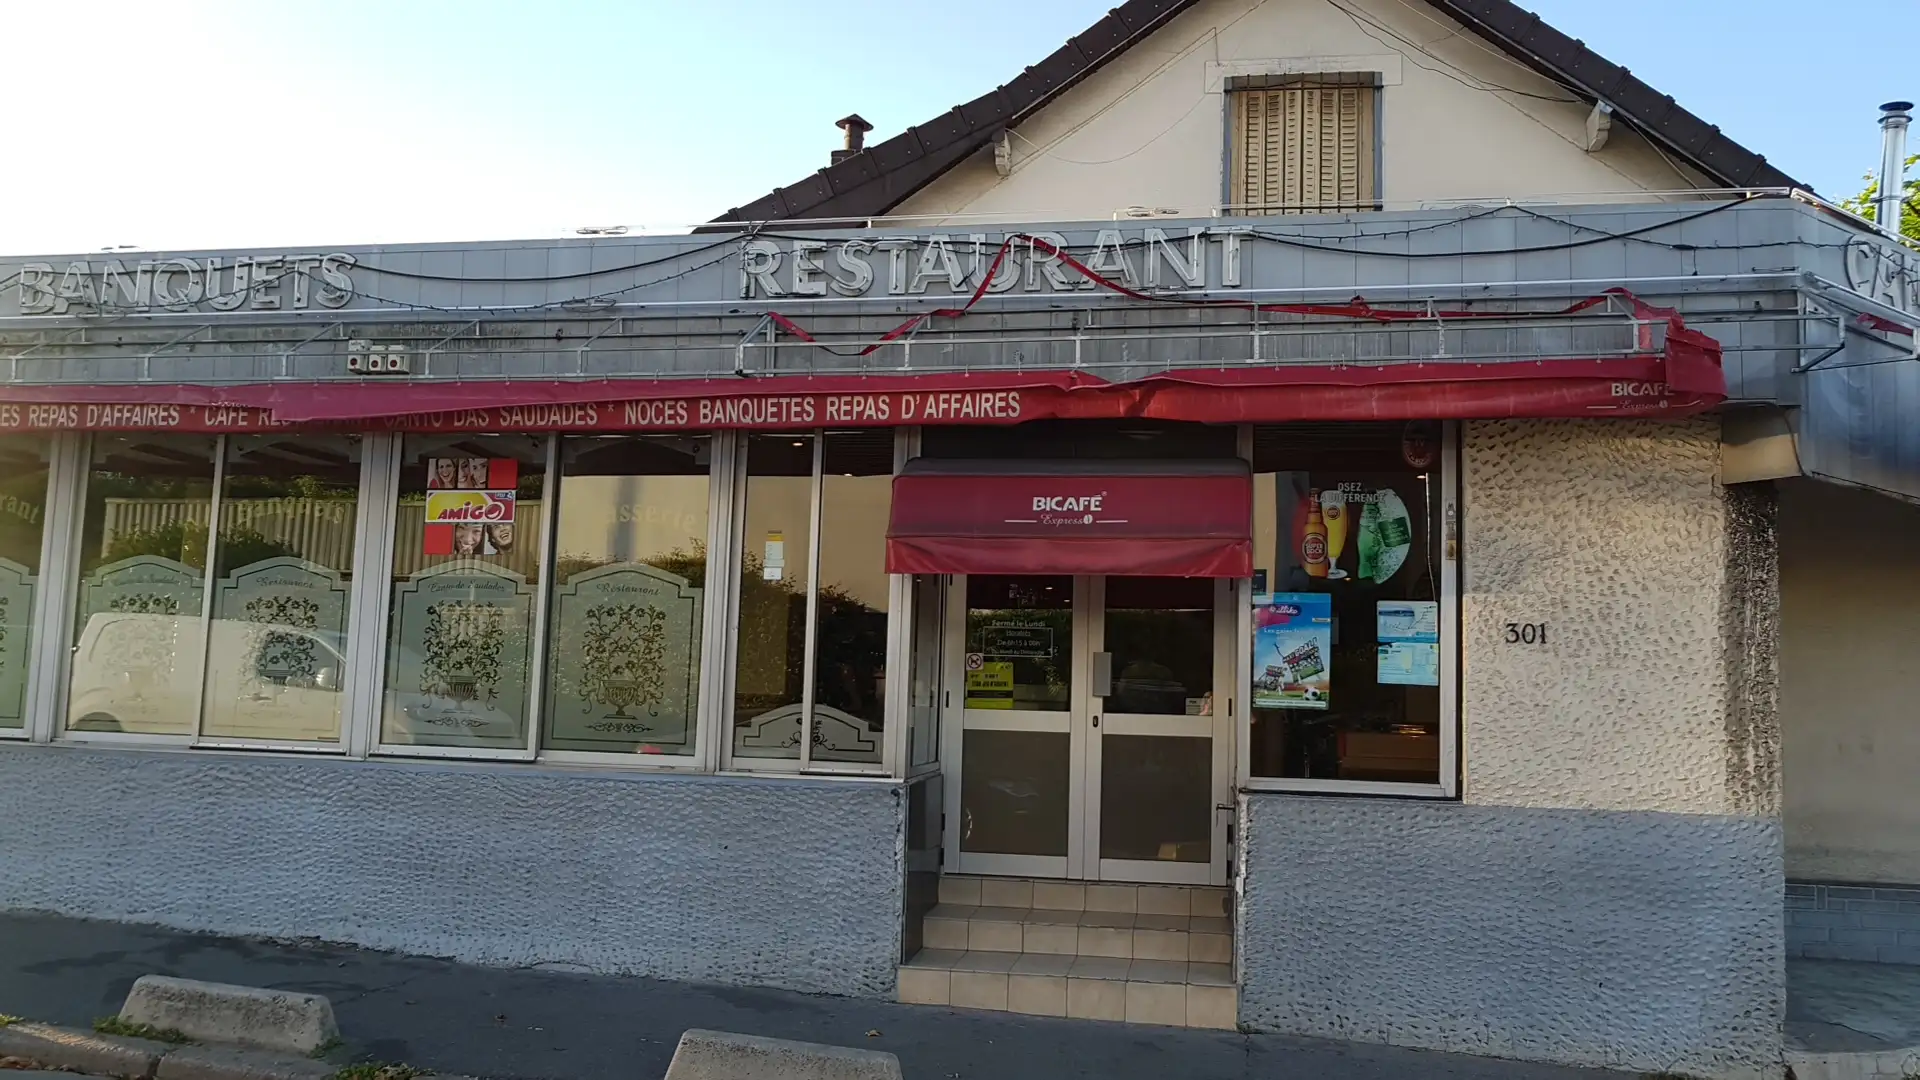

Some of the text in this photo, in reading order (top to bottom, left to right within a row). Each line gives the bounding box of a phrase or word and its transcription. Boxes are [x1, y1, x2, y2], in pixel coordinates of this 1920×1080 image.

[740, 225, 1253, 299] RESTAURANT
[19, 252, 357, 314] BANQUETS
[28, 405, 78, 427] REPAS
[87, 404, 181, 427] D'AFFAIRES
[500, 402, 598, 427] SAUDADES
[624, 400, 688, 426] NOCES
[700, 396, 815, 425] BANQUETES
[826, 395, 890, 422] REPAS
[1337, 482, 1362, 492] OSEZ
[1032, 494, 1103, 511] BICAFÉ
[1505, 622, 1547, 644] 301
